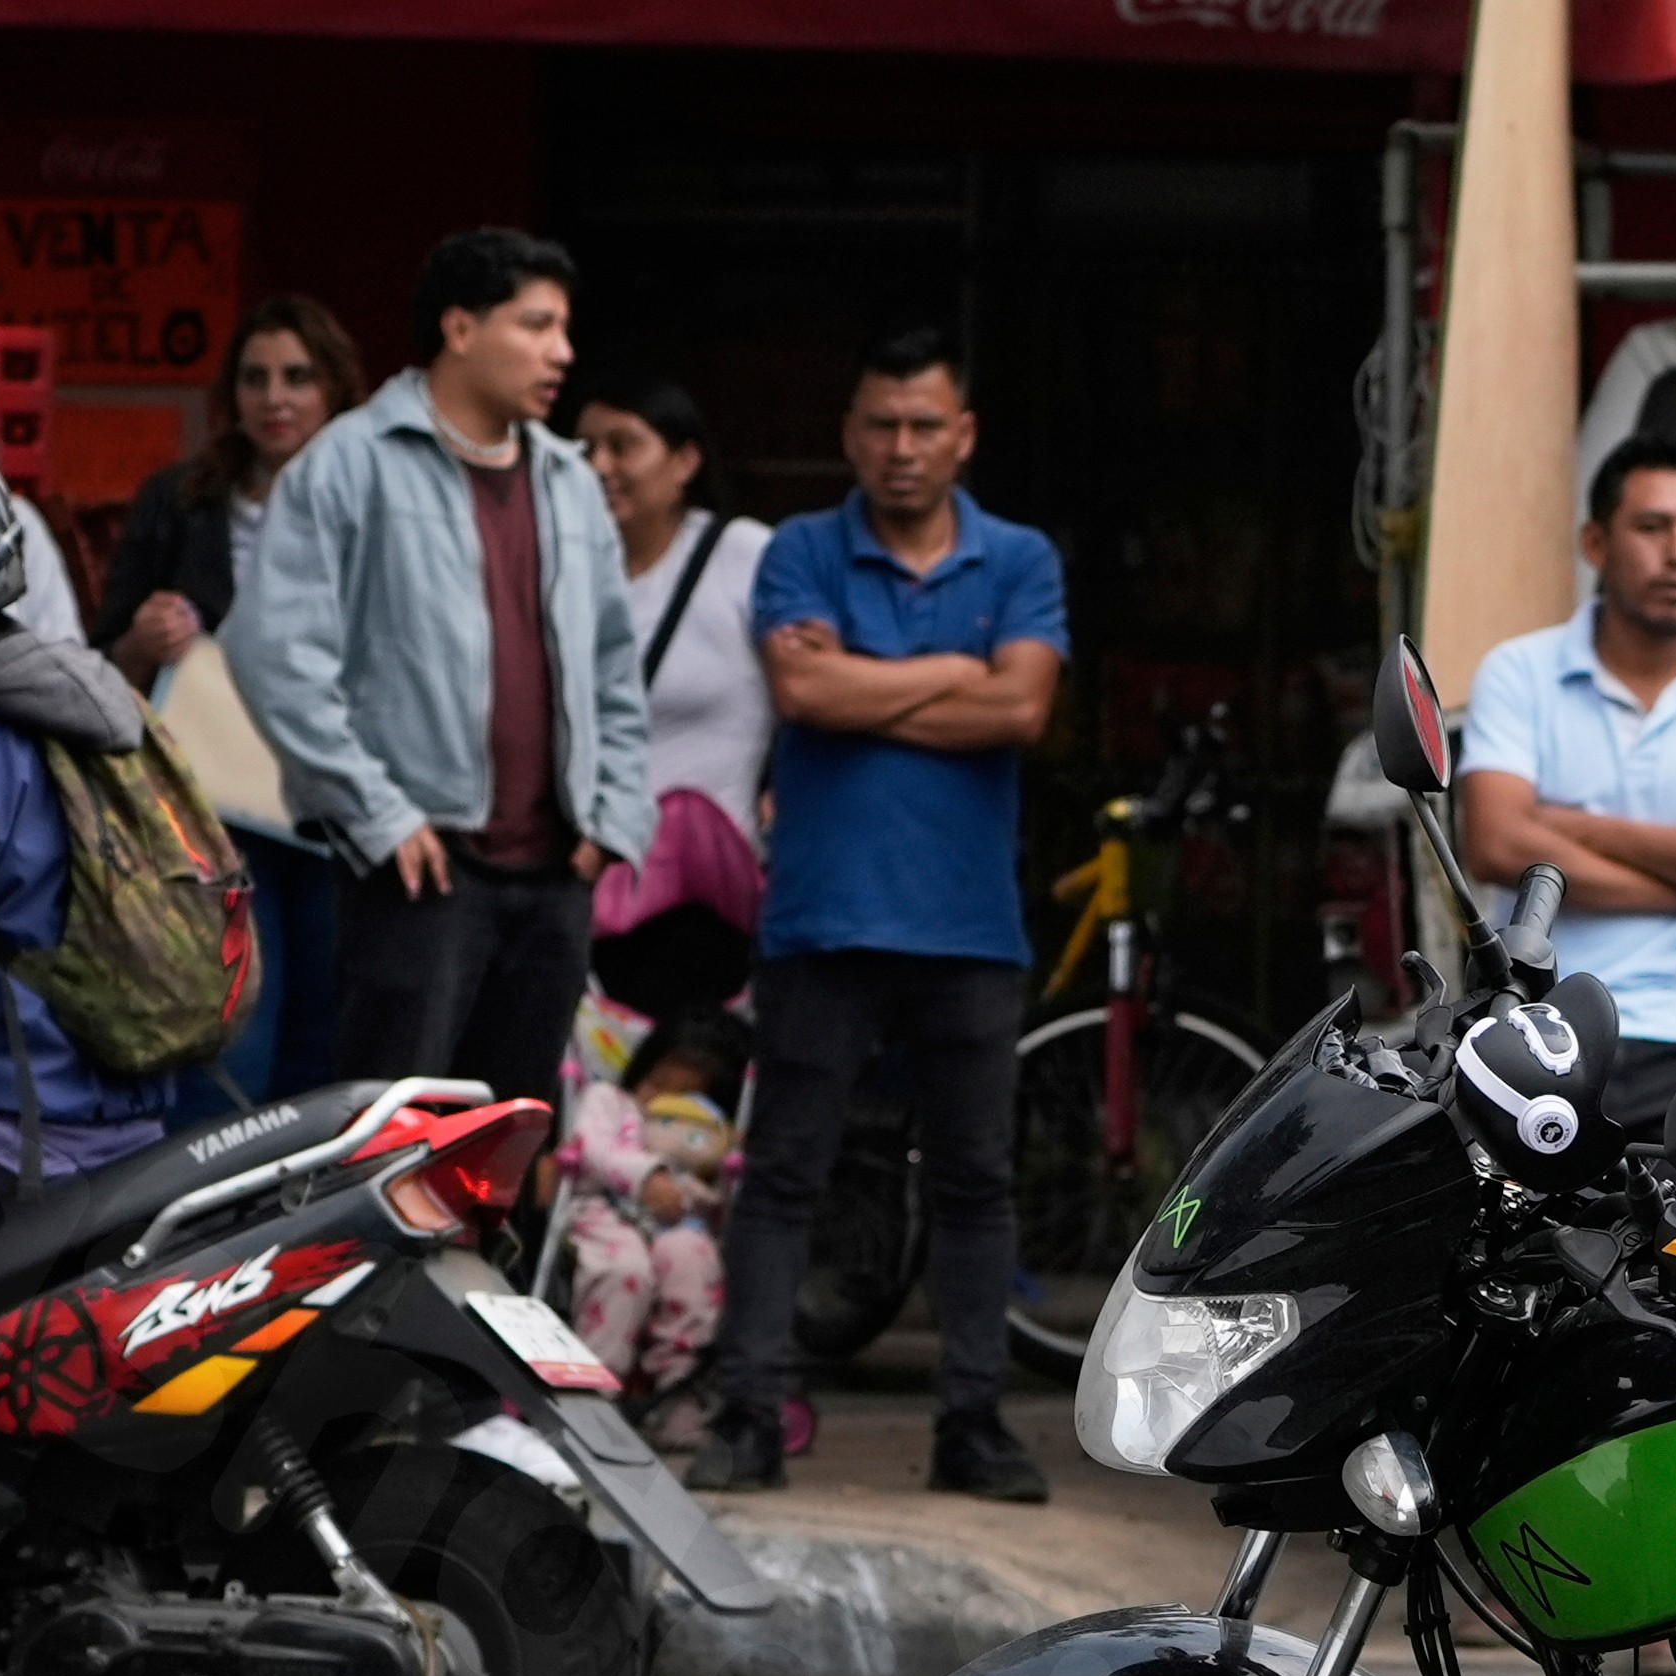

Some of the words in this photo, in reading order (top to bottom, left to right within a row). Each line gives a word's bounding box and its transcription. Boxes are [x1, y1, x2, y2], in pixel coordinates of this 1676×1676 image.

[2, 209, 211, 268] VENTA
[2, 308, 208, 367] IELO
[186, 1104, 300, 1164] YAMAHA
